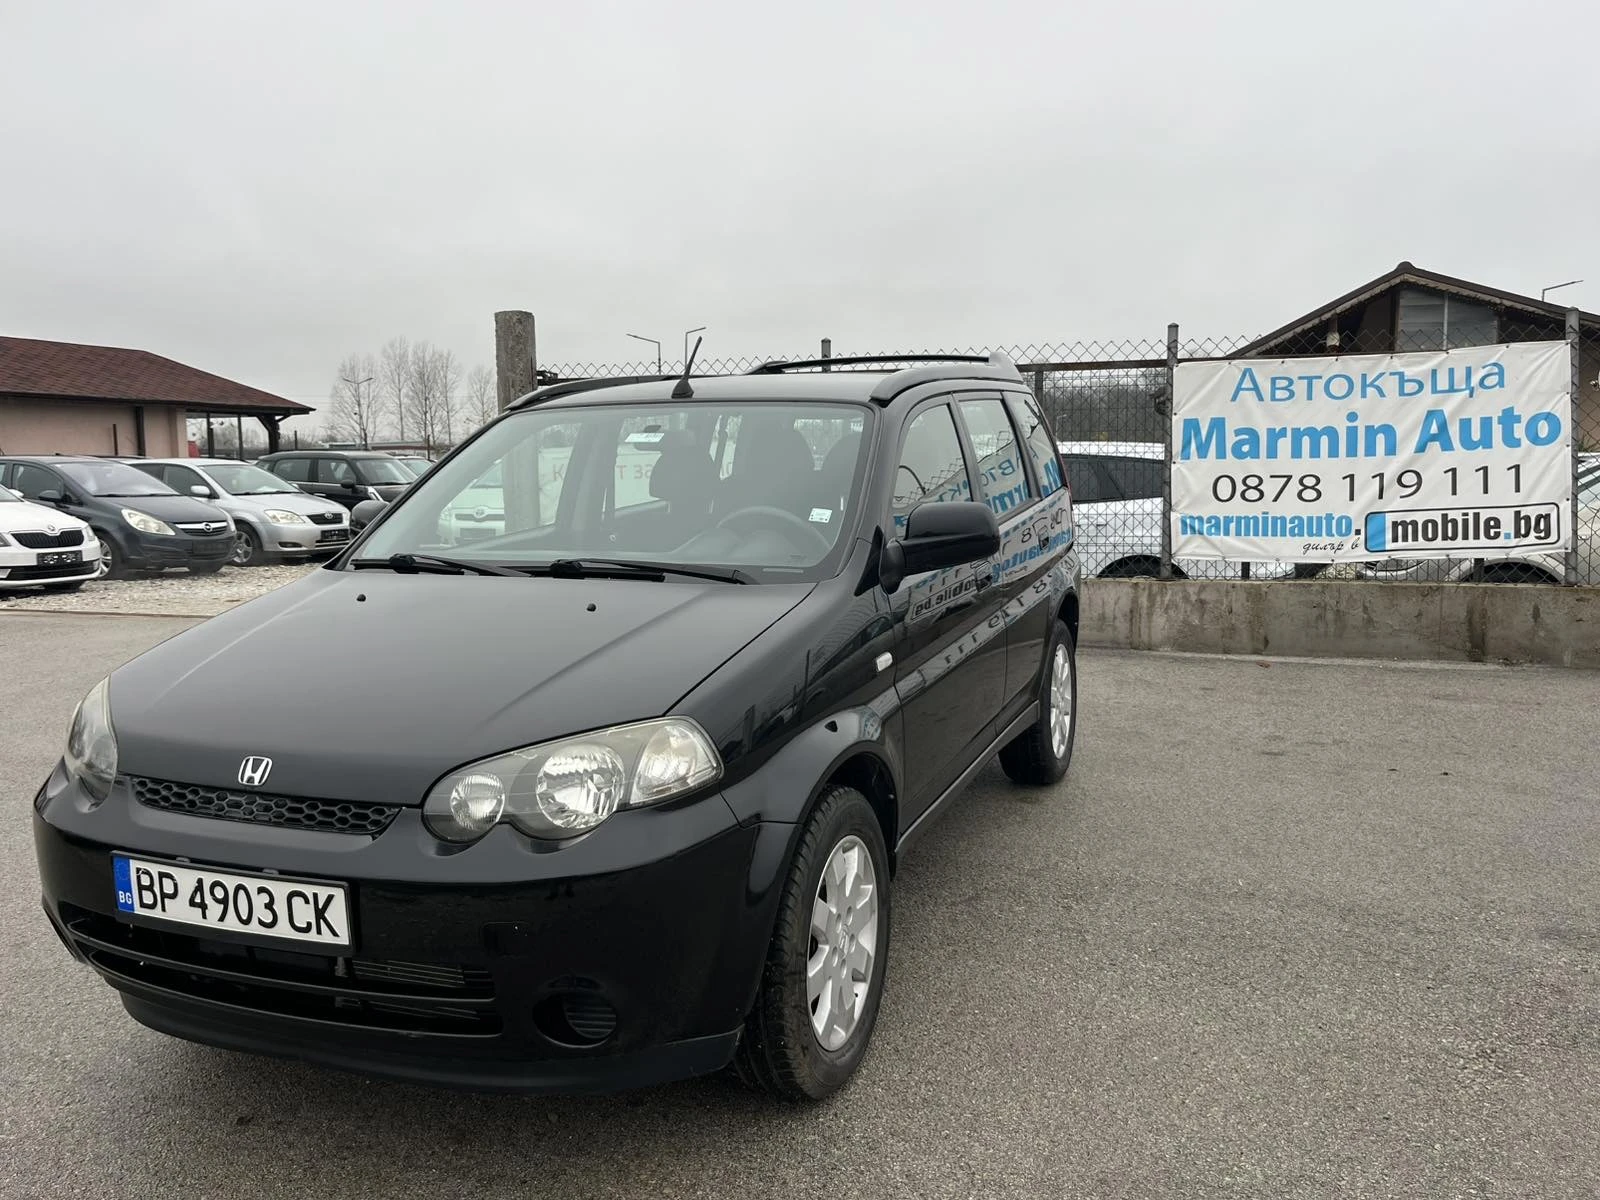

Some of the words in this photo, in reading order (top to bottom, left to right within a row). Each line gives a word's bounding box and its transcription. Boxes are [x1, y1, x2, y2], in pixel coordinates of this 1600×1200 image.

[1230, 361, 1505, 402] Автокъща
[1180, 411, 1397, 461] Marmin
[1414, 405, 1562, 454] Auto
[1211, 473, 1323, 503] 0878
[1342, 469, 1423, 500] 119
[1443, 463, 1522, 496] 111
[1391, 510, 1552, 542] mobile.bg
[118, 891, 132, 904] BG
[135, 867, 179, 913] BP
[188, 877, 279, 929] 4903
[286, 890, 340, 938] CK
